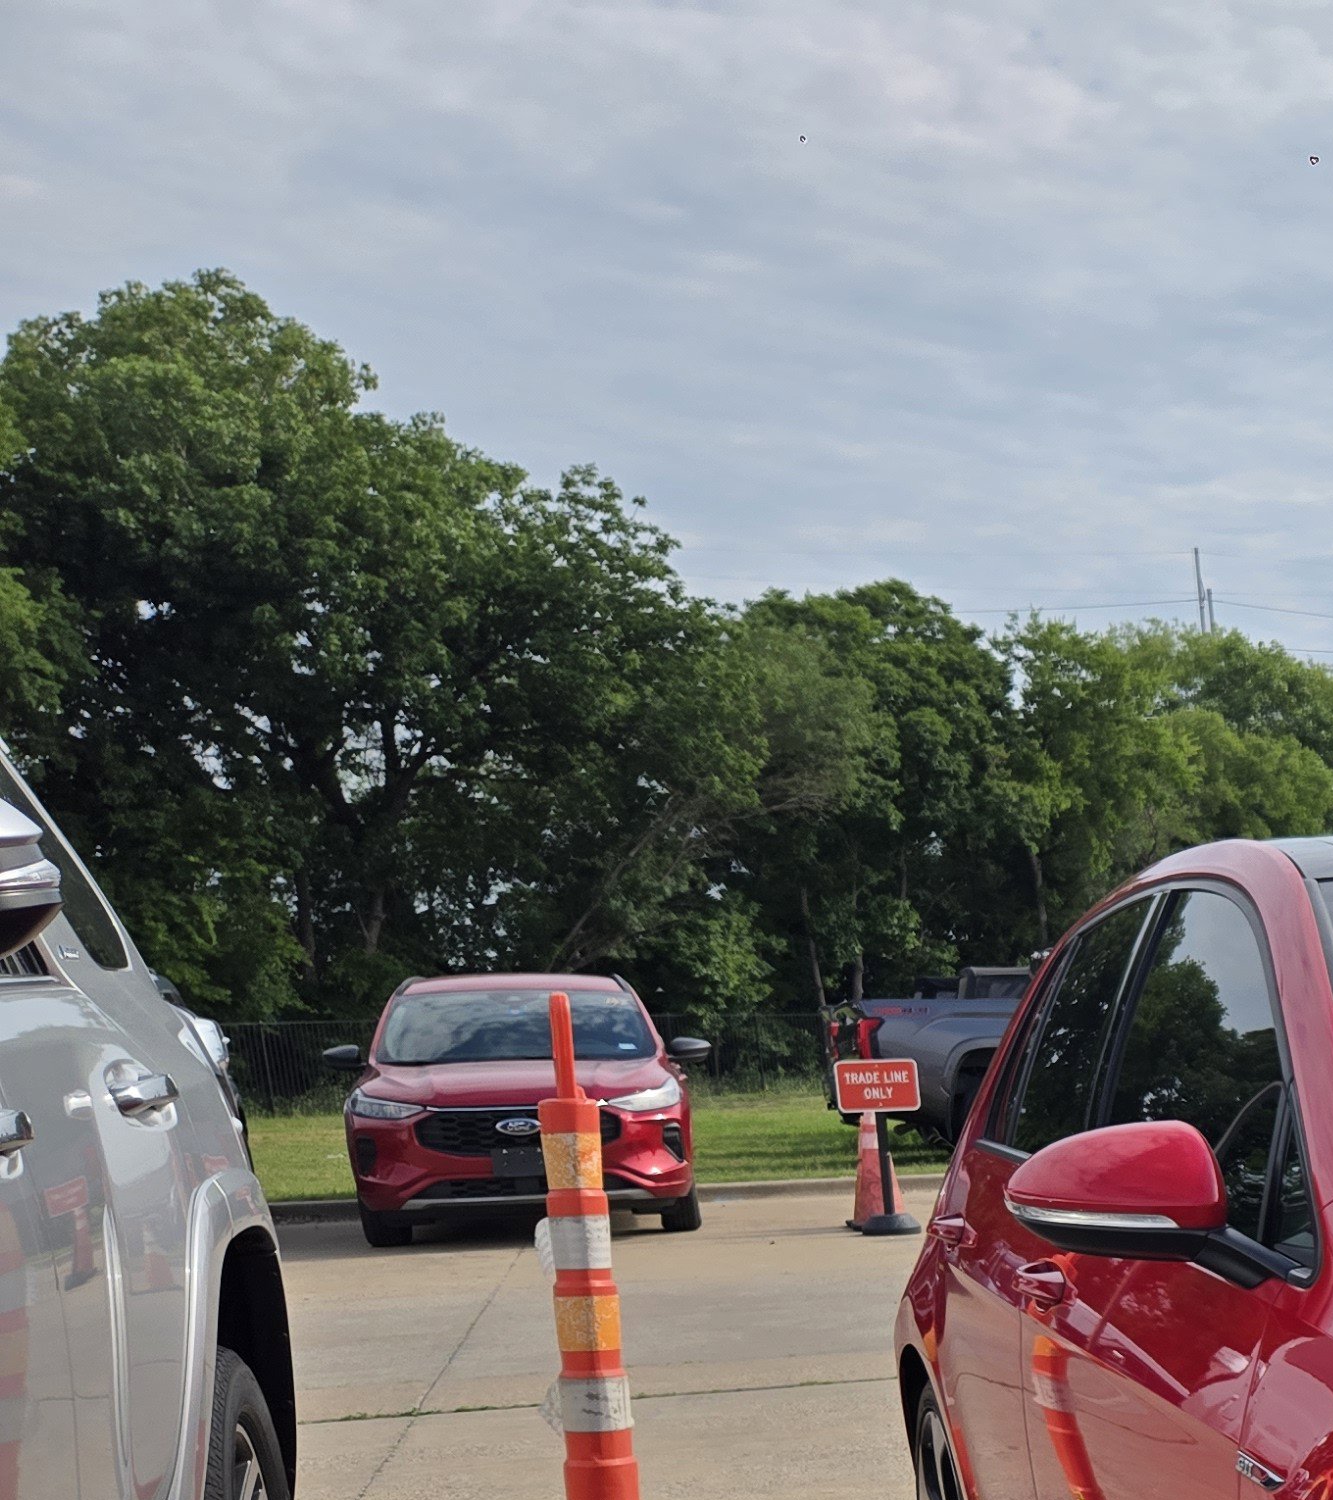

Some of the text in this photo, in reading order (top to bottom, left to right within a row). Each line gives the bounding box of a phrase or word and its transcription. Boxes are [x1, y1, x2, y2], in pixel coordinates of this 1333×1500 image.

[844, 1070, 909, 1085] TRADE LINE
[863, 1086, 893, 1100] ONLY
